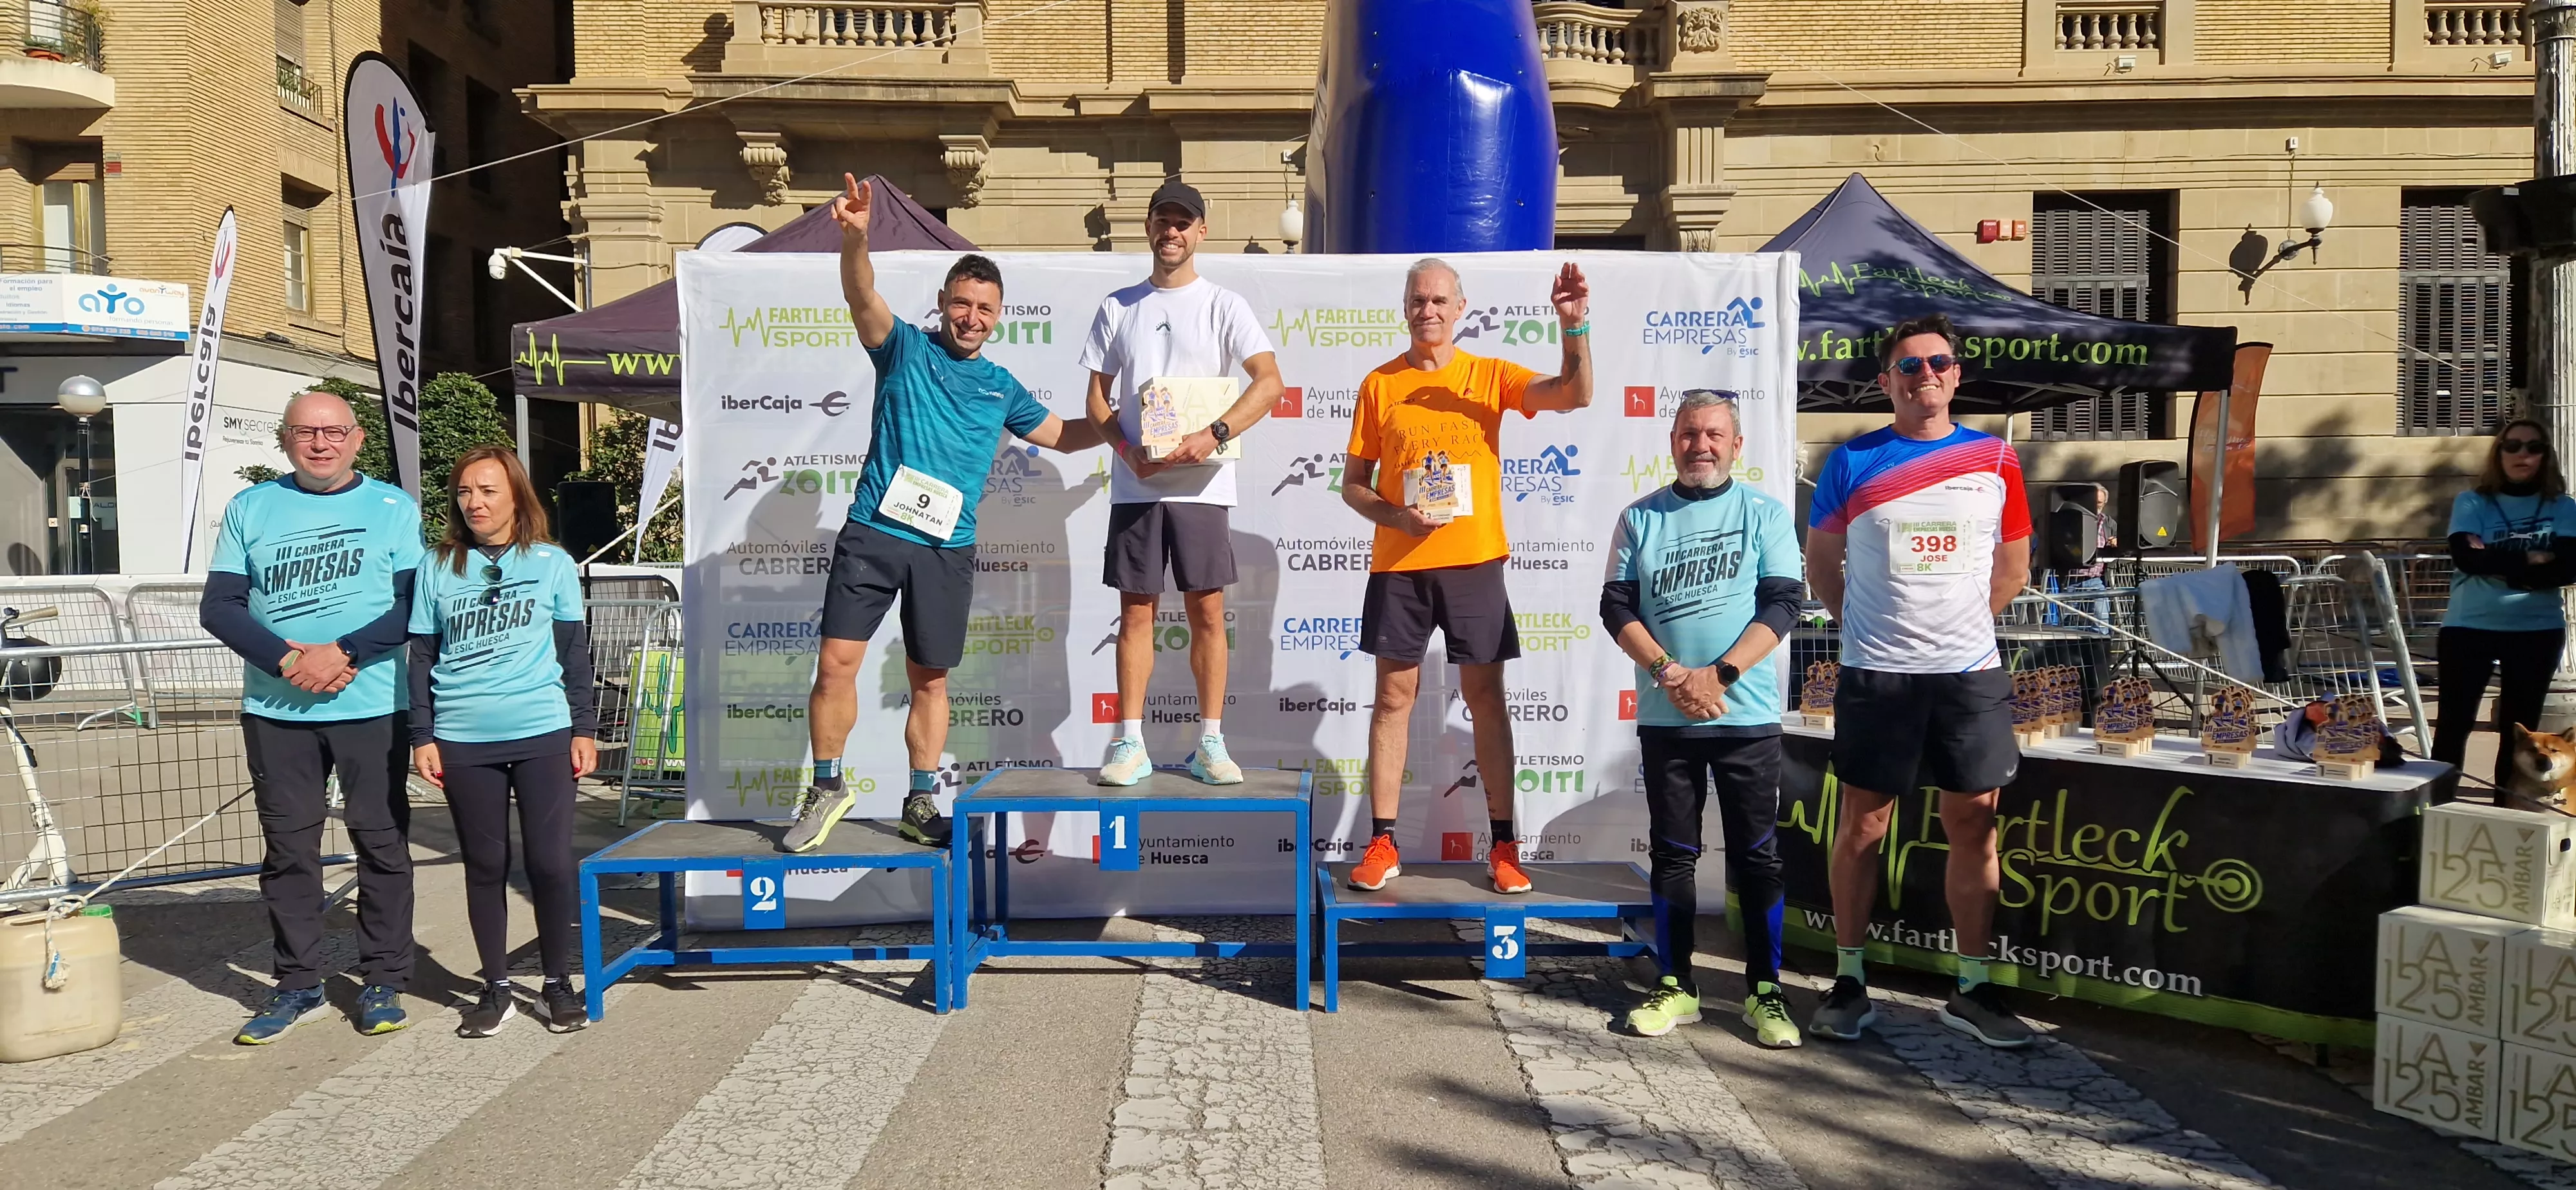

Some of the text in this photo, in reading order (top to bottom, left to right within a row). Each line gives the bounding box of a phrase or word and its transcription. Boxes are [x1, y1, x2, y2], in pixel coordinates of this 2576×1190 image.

[1003, 305, 1052, 316] TISMO
[1316, 309, 1396, 324] FARTLECK
[1645, 311, 1745, 327] CARRERA
[380, 213, 417, 432] Ibercaja
[773, 331, 855, 348] SPORT
[985, 321, 1052, 345] OITI
[1320, 332, 1397, 347] SPORT
[1643, 328, 1747, 345] EMPRESAS
[1727, 348, 1738, 357] By
[721, 395, 802, 413] iberCaja
[1660, 405, 1676, 418] de
[1307, 408, 1325, 419] de
[1399, 420, 1478, 440] RUN FAST
[779, 469, 859, 496] ZOIT
[920, 478, 949, 495] CARRERA
[1501, 476, 1562, 492] RESAS
[1001, 496, 1012, 505] By
[1426, 484, 1455, 500] EMPRESAS
[1540, 495, 1551, 505] By
[916, 493, 931, 509] 9
[893, 502, 943, 527] JOHNATAN
[900, 512, 914, 523] 8K
[276, 538, 345, 562] III CARRERA
[726, 540, 827, 554] Automóviles
[974, 540, 1055, 554] ntamiento
[1275, 536, 1373, 551] Automóviles
[1509, 538, 1595, 552] untamiento
[1911, 535, 1957, 552] 398
[1287, 553, 1373, 571] CABRER
[1665, 542, 1724, 565] III CARRERA
[264, 548, 365, 596] EMPRESAS
[739, 557, 831, 576] CABRER
[1511, 557, 1569, 571] Huesca
[1917, 563, 1932, 572] 8K
[1651, 551, 1741, 599] EMPRESAS
[278, 583, 337, 604] ESIC HUESCA
[1665, 584, 1718, 605] ESIC HUESCA
[452, 598, 468, 612] III
[1283, 618, 1363, 634] CARRER
[1514, 613, 1572, 628] RTLECK
[454, 632, 510, 654] ESIC HUESCA
[725, 639, 819, 656] EMPRESA
[1280, 635, 1361, 650] EMPRES
[727, 704, 804, 722] iberCaja
[1279, 697, 1356, 715] iberCaja
[949, 708, 1023, 727] BRERO
[1151, 710, 1201, 723] Huesc
[2103, 721, 2137, 732] EMPRESAS
[2211, 730, 2249, 741] EMPRESAS
[2098, 744, 2103, 755] 1
[1515, 755, 1584, 766] TLETISMO
[2208, 754, 2213, 765] 1
[1515, 769, 1584, 793] OITI
[1109, 815, 1127, 849] 1
[1919, 785, 2194, 873] Frtleck
[1139, 835, 1235, 851] yuntamiento
[1150, 851, 1209, 864] Huesca
[1520, 849, 1555, 861] esca
[2429, 851, 2509, 910] 125
[2512, 844, 2534, 914] AMBAR
[750, 876, 777, 911] 2
[1999, 848, 2189, 936] Sport
[1492, 925, 1519, 960] 3
[2384, 958, 2464, 1022] 125
[2466, 956, 2489, 1028] AMBAR
[2383, 1057, 2461, 1122] 125
[2465, 1059, 2486, 1130] AMBAR
